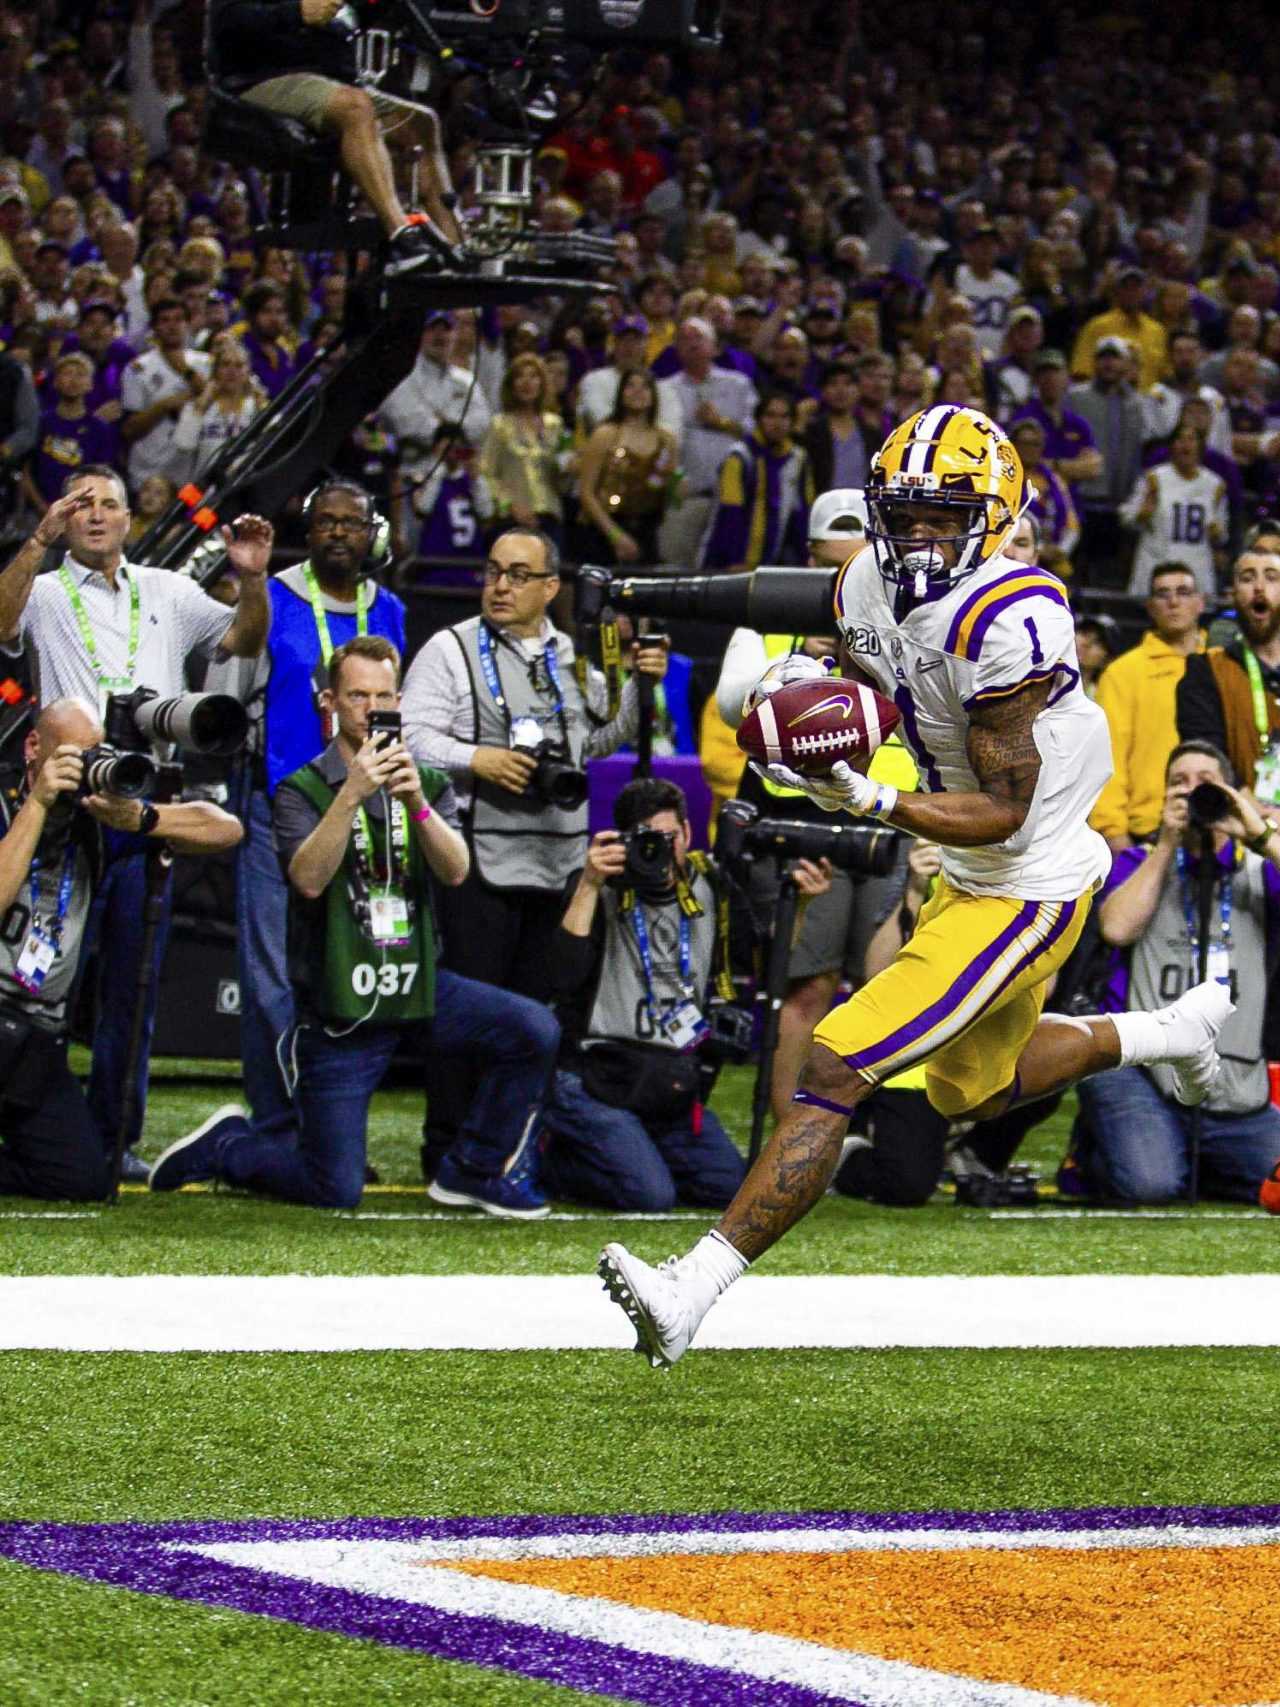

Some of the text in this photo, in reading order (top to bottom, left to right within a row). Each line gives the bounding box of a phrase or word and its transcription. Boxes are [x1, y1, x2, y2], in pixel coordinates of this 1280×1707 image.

[901, 475, 926, 487] LSU
[447, 499, 476, 548] 5
[1172, 503, 1206, 543] 18
[1024, 616, 1045, 666] 1
[351, 962, 419, 996] 037
